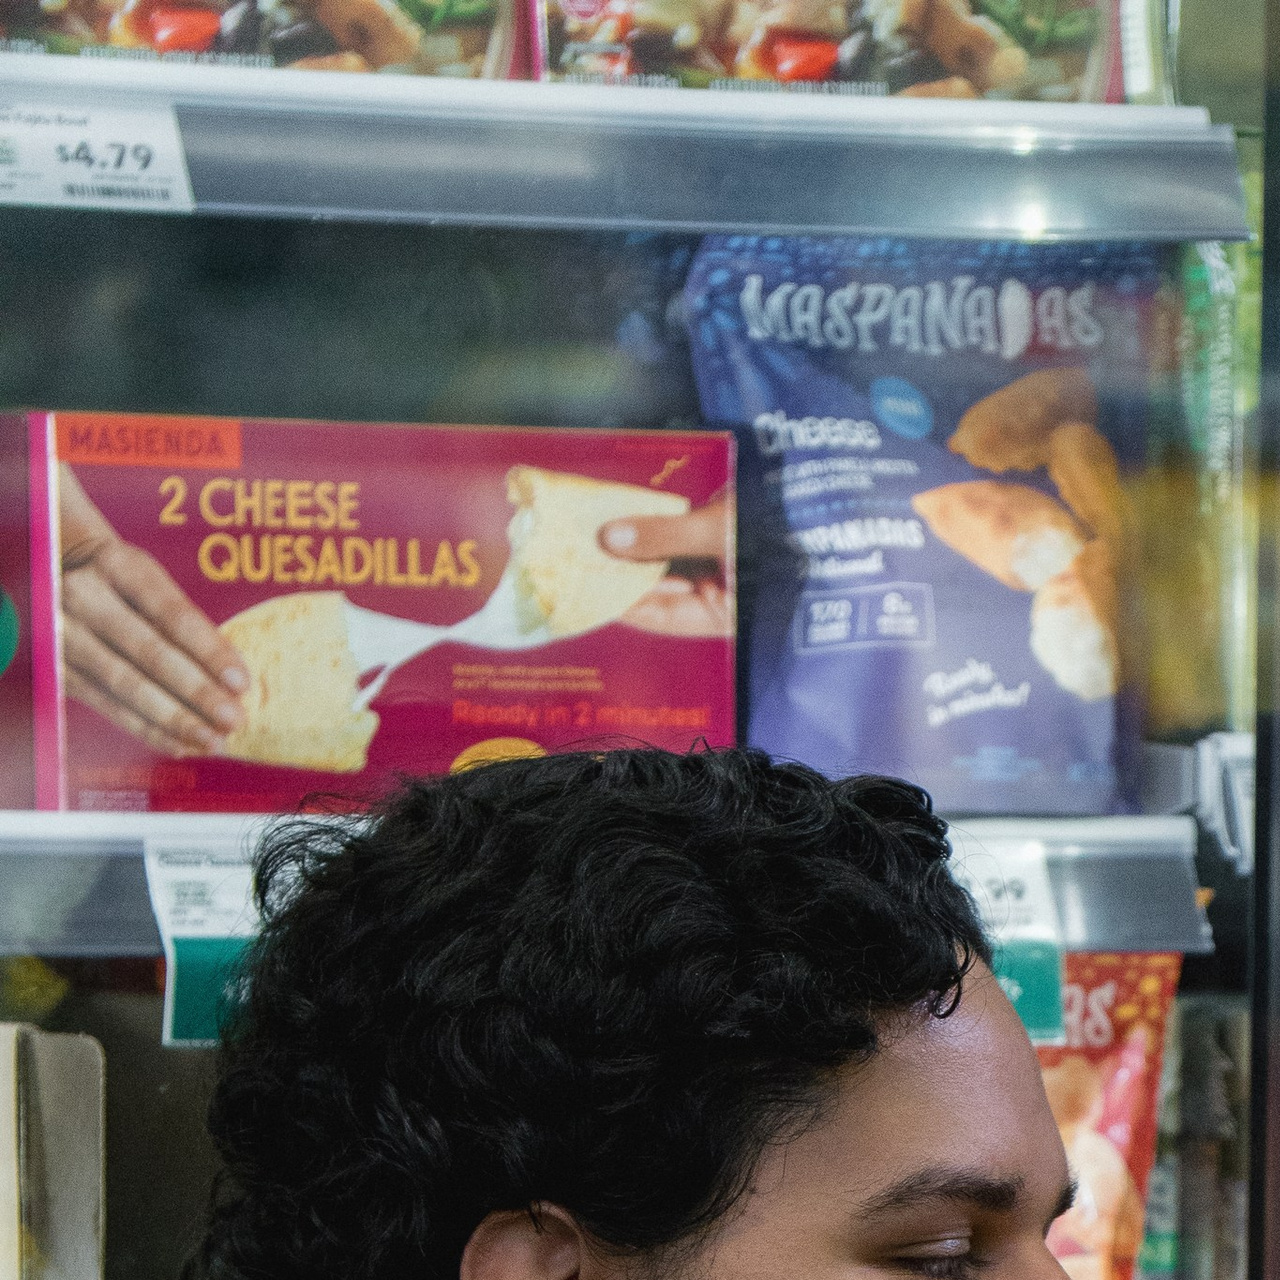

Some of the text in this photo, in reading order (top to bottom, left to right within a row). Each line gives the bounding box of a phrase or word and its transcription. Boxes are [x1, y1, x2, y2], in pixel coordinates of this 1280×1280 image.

[57, 139, 153, 171] $4.79
[68, 426, 226, 458] MASIENDA
[755, 411, 881, 456] Cheese
[159, 477, 361, 529] 2 CHEESE
[198, 534, 481, 587] QUESADILLAS
